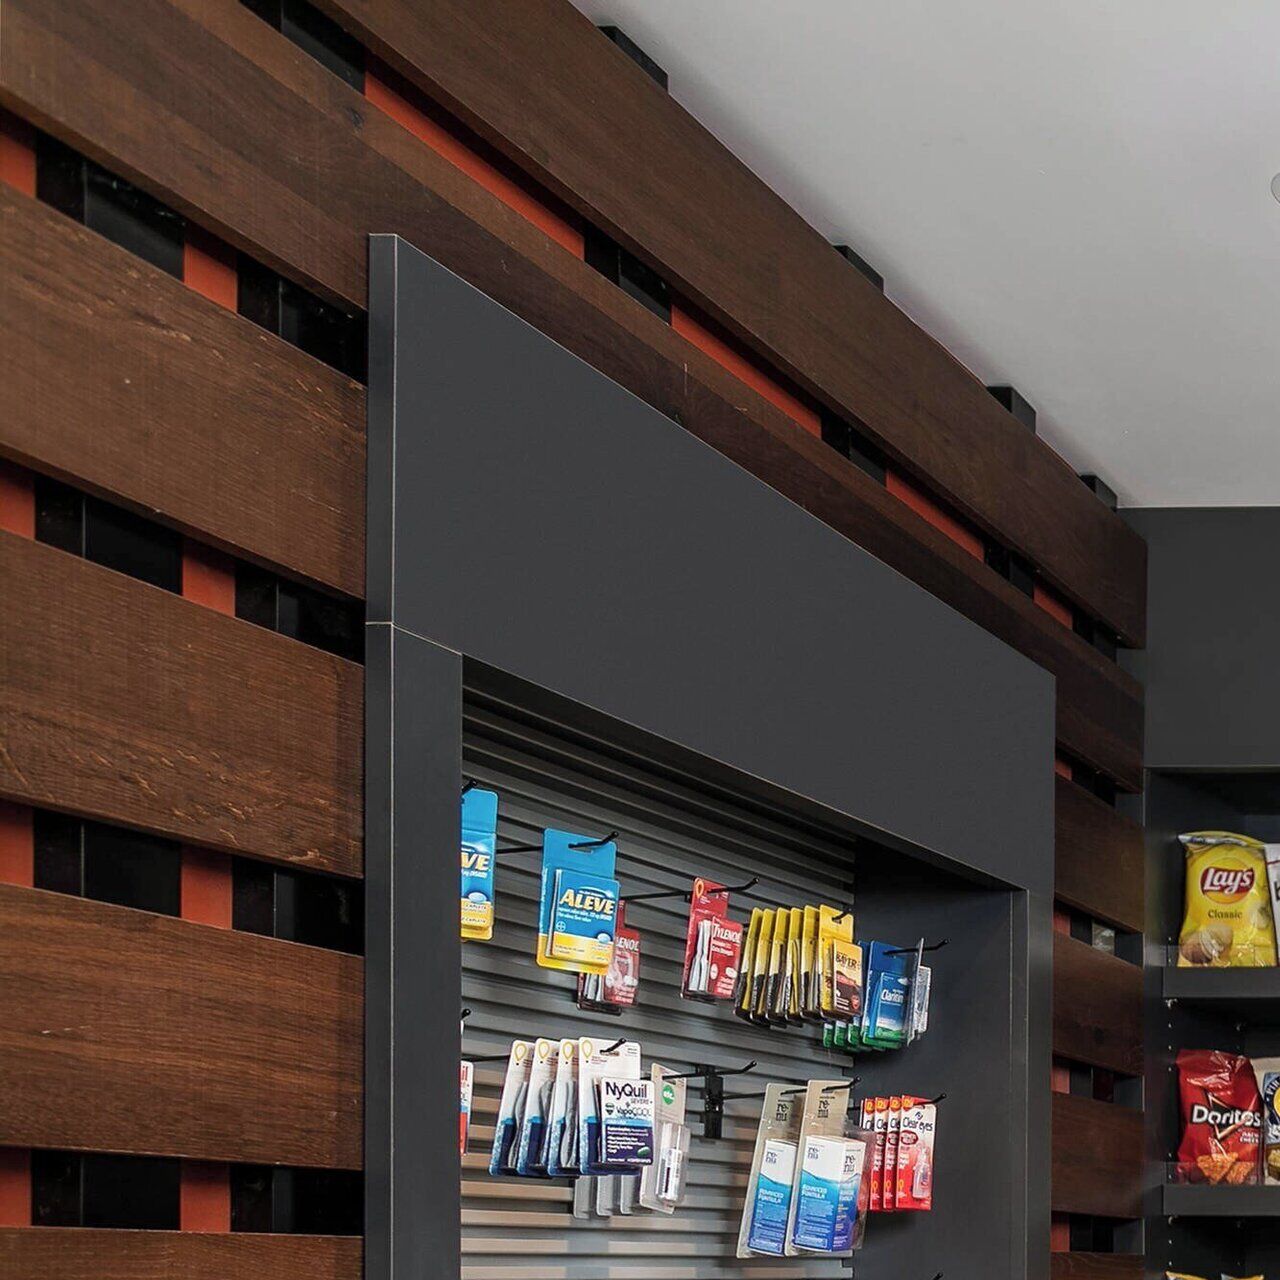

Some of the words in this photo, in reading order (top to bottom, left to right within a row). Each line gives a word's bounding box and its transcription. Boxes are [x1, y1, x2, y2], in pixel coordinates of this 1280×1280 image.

[1203, 867, 1254, 895] Lay's
[559, 889, 615, 915] ALEVE
[1207, 908, 1243, 920] Classic
[605, 1081, 648, 1100] NyQuil
[903, 1116, 918, 1129] Clear
[918, 1120, 934, 1132] eyes
[1192, 1104, 1261, 1128] Doritos
